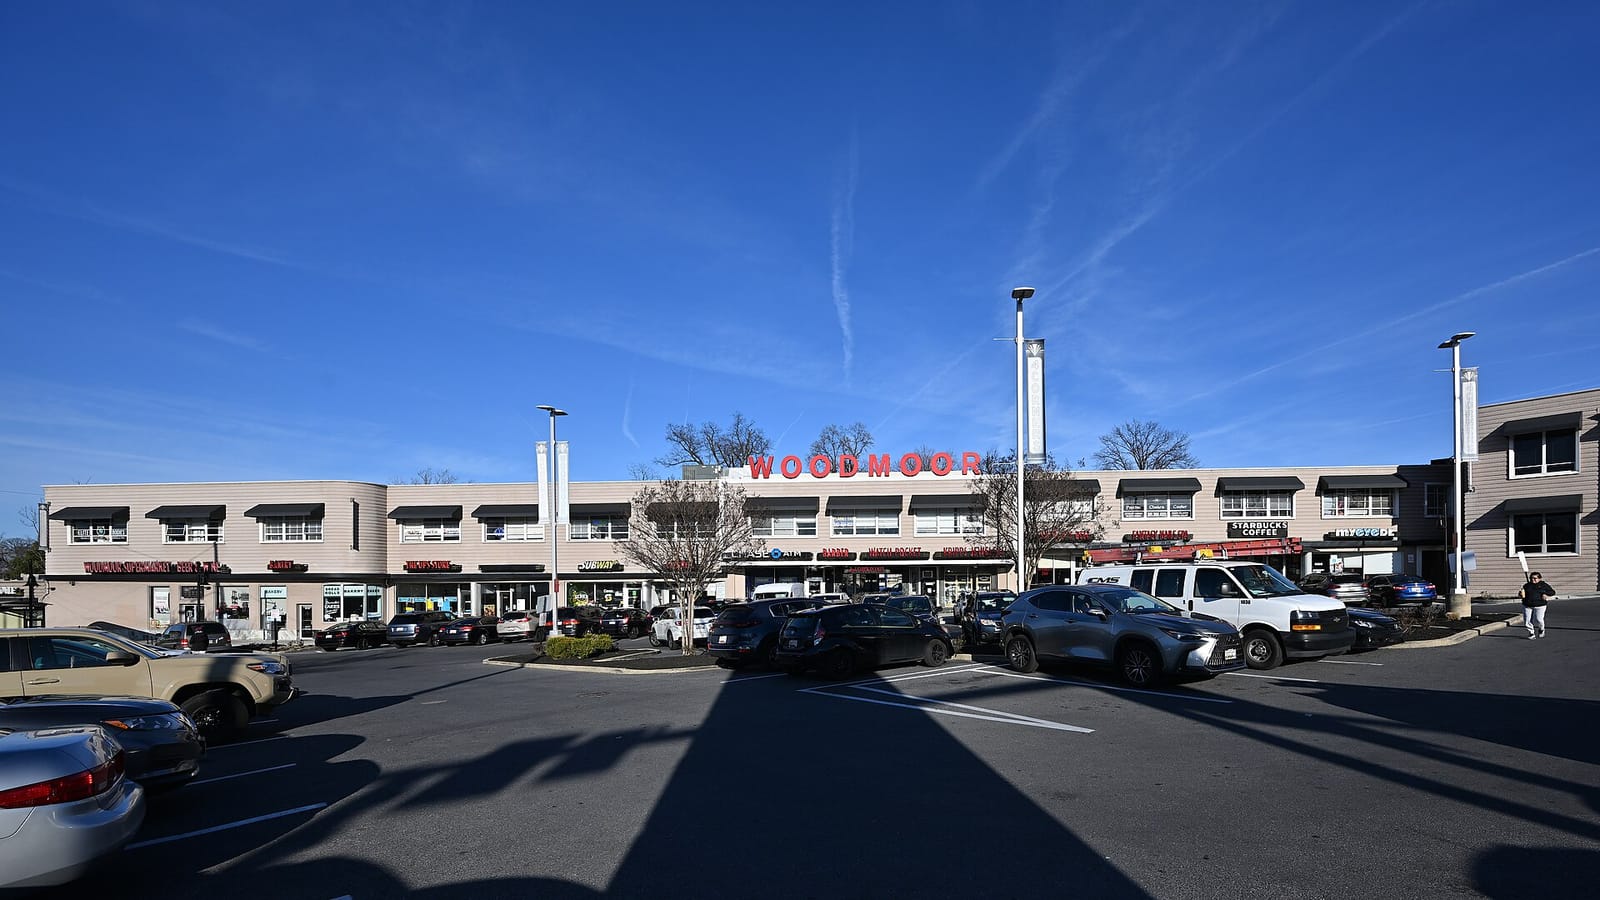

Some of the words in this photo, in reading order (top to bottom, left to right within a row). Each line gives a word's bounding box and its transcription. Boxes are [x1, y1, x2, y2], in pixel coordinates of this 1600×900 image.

[749, 451, 981, 480] WOODMOOR
[84, 562, 122, 573] WOODMOOR
[123, 562, 170, 573] SUPERMARKET
[578, 560, 618, 569] SUBWAY
